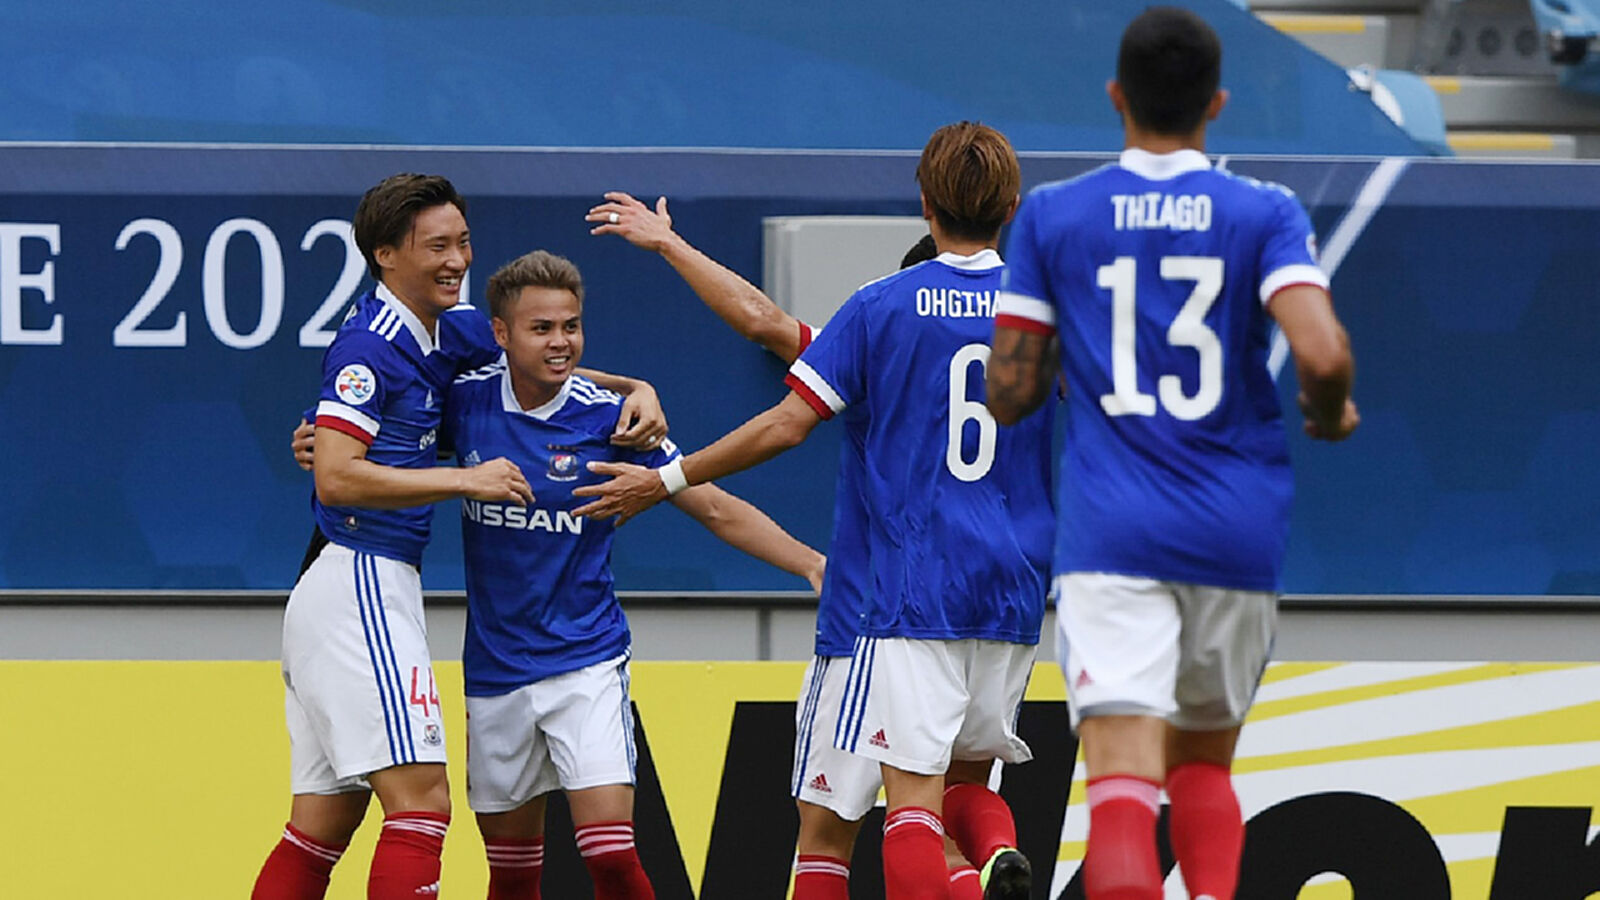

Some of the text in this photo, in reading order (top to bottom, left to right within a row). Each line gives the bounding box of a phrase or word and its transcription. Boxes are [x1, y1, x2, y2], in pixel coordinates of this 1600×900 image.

[1111, 193, 1212, 231] THIAGO
[113, 218, 470, 349] 202
[1097, 256, 1225, 421] 13
[946, 343, 998, 482] 6
[462, 499, 583, 535] NISSAN
